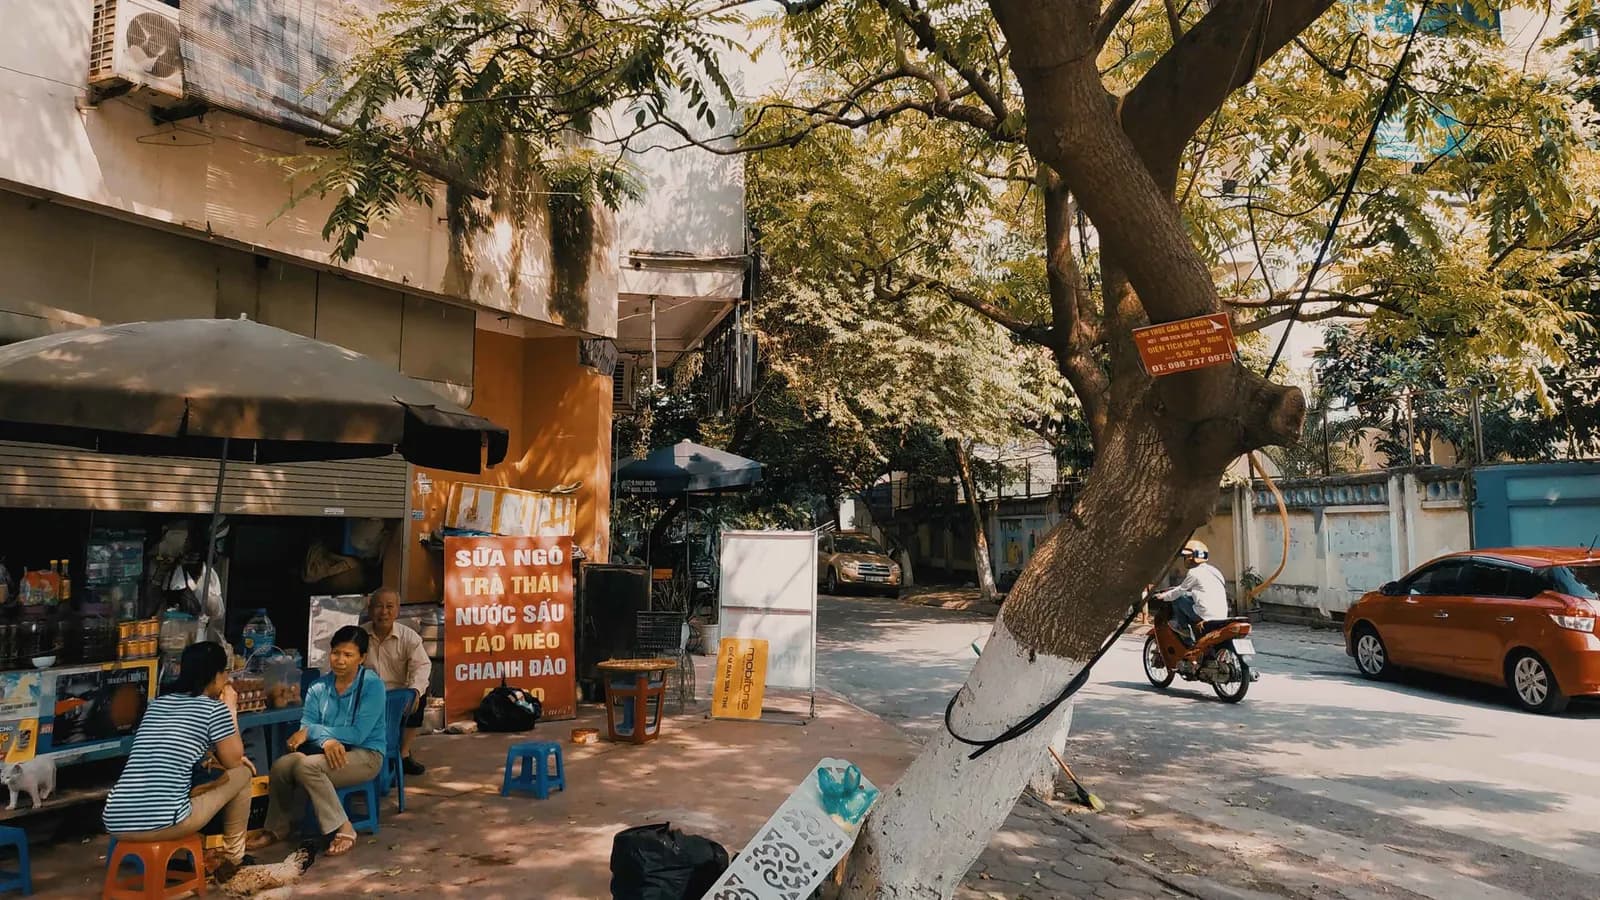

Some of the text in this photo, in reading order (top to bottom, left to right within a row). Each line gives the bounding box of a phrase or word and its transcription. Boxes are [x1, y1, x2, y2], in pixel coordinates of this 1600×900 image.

[1147, 344, 1166, 354] DIỆN
[1166, 341, 1184, 351] TÍCH
[1151, 353, 1231, 373] ĐT: 098 737 0975
[455, 545, 564, 568] SỮA NGÔ
[461, 571, 560, 596] TRÀ THÁI
[455, 598, 565, 627] NƯỚC SẤU
[461, 629, 560, 654] TÁO MÈO
[455, 654, 567, 682] CHANH ĐÀO
[741, 647, 757, 711] mobifone
